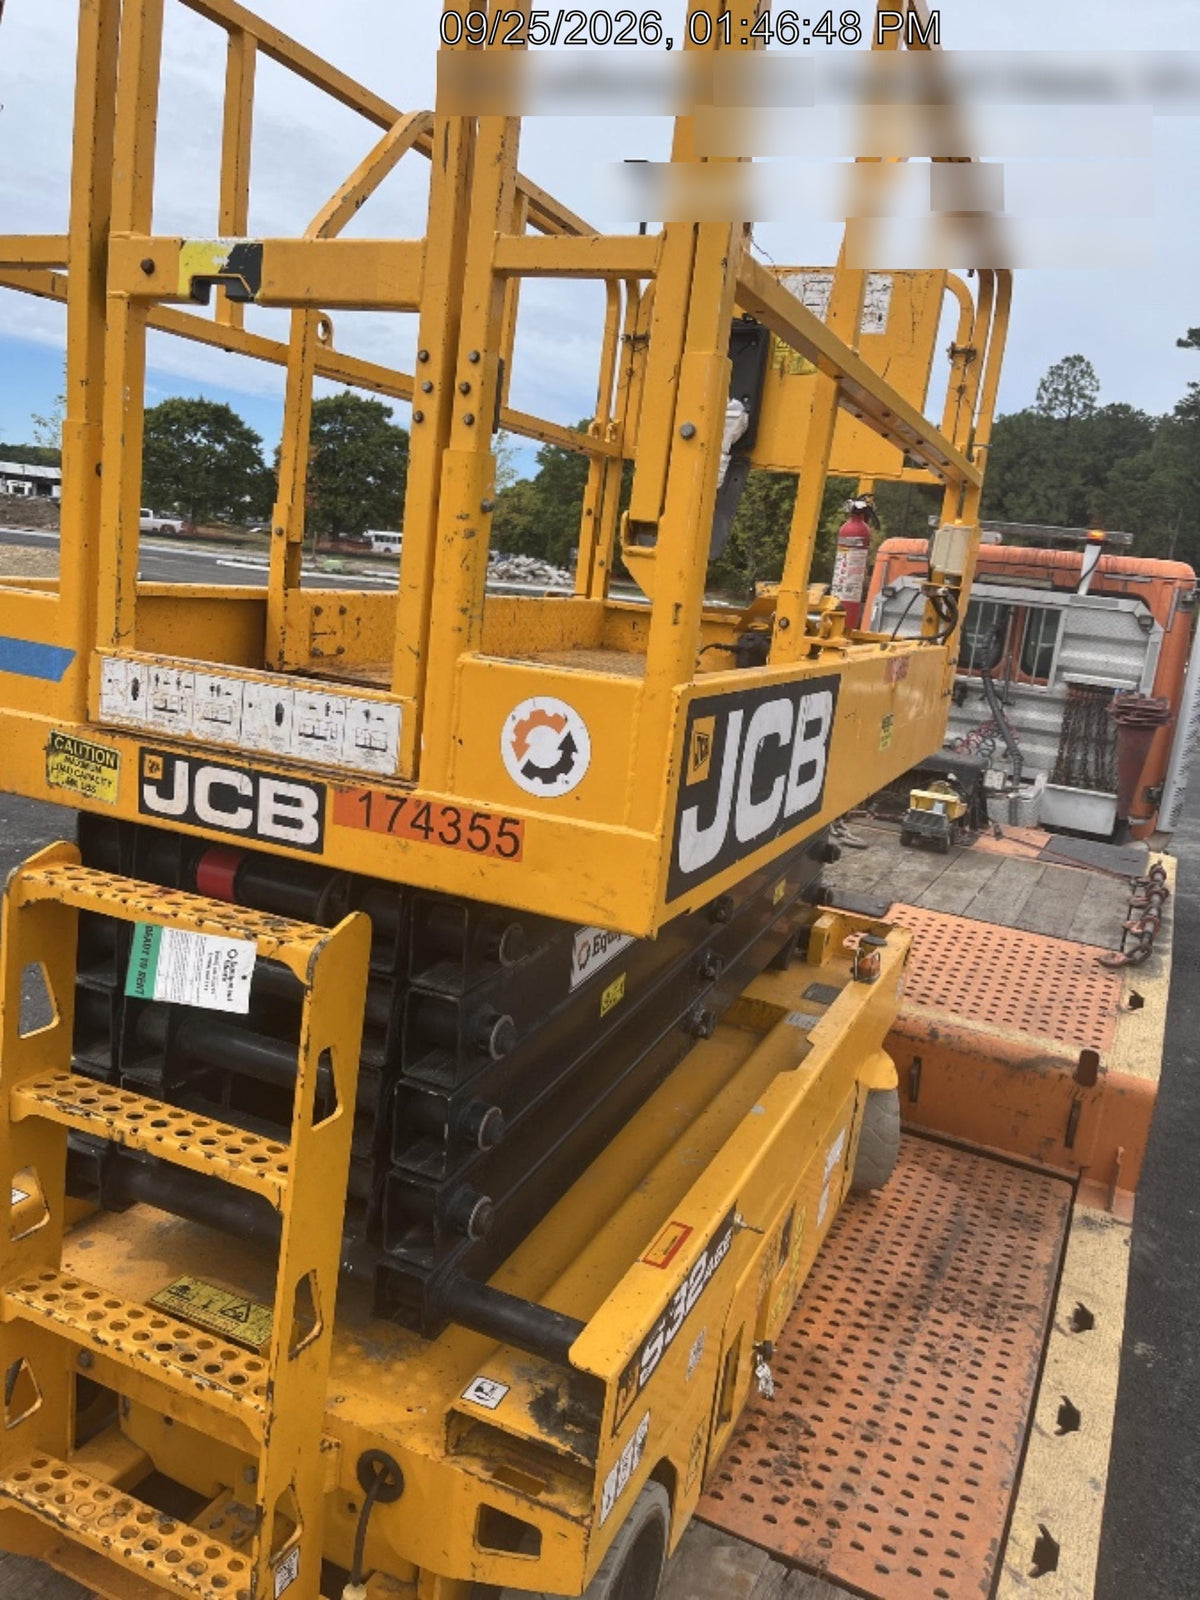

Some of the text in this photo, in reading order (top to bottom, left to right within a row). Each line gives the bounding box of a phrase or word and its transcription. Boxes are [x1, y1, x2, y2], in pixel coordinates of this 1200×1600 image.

[54, 737, 116, 769] CAUTION
[678, 690, 833, 874] JCB
[143, 760, 319, 845] JCB
[358, 790, 521, 858] 174355
